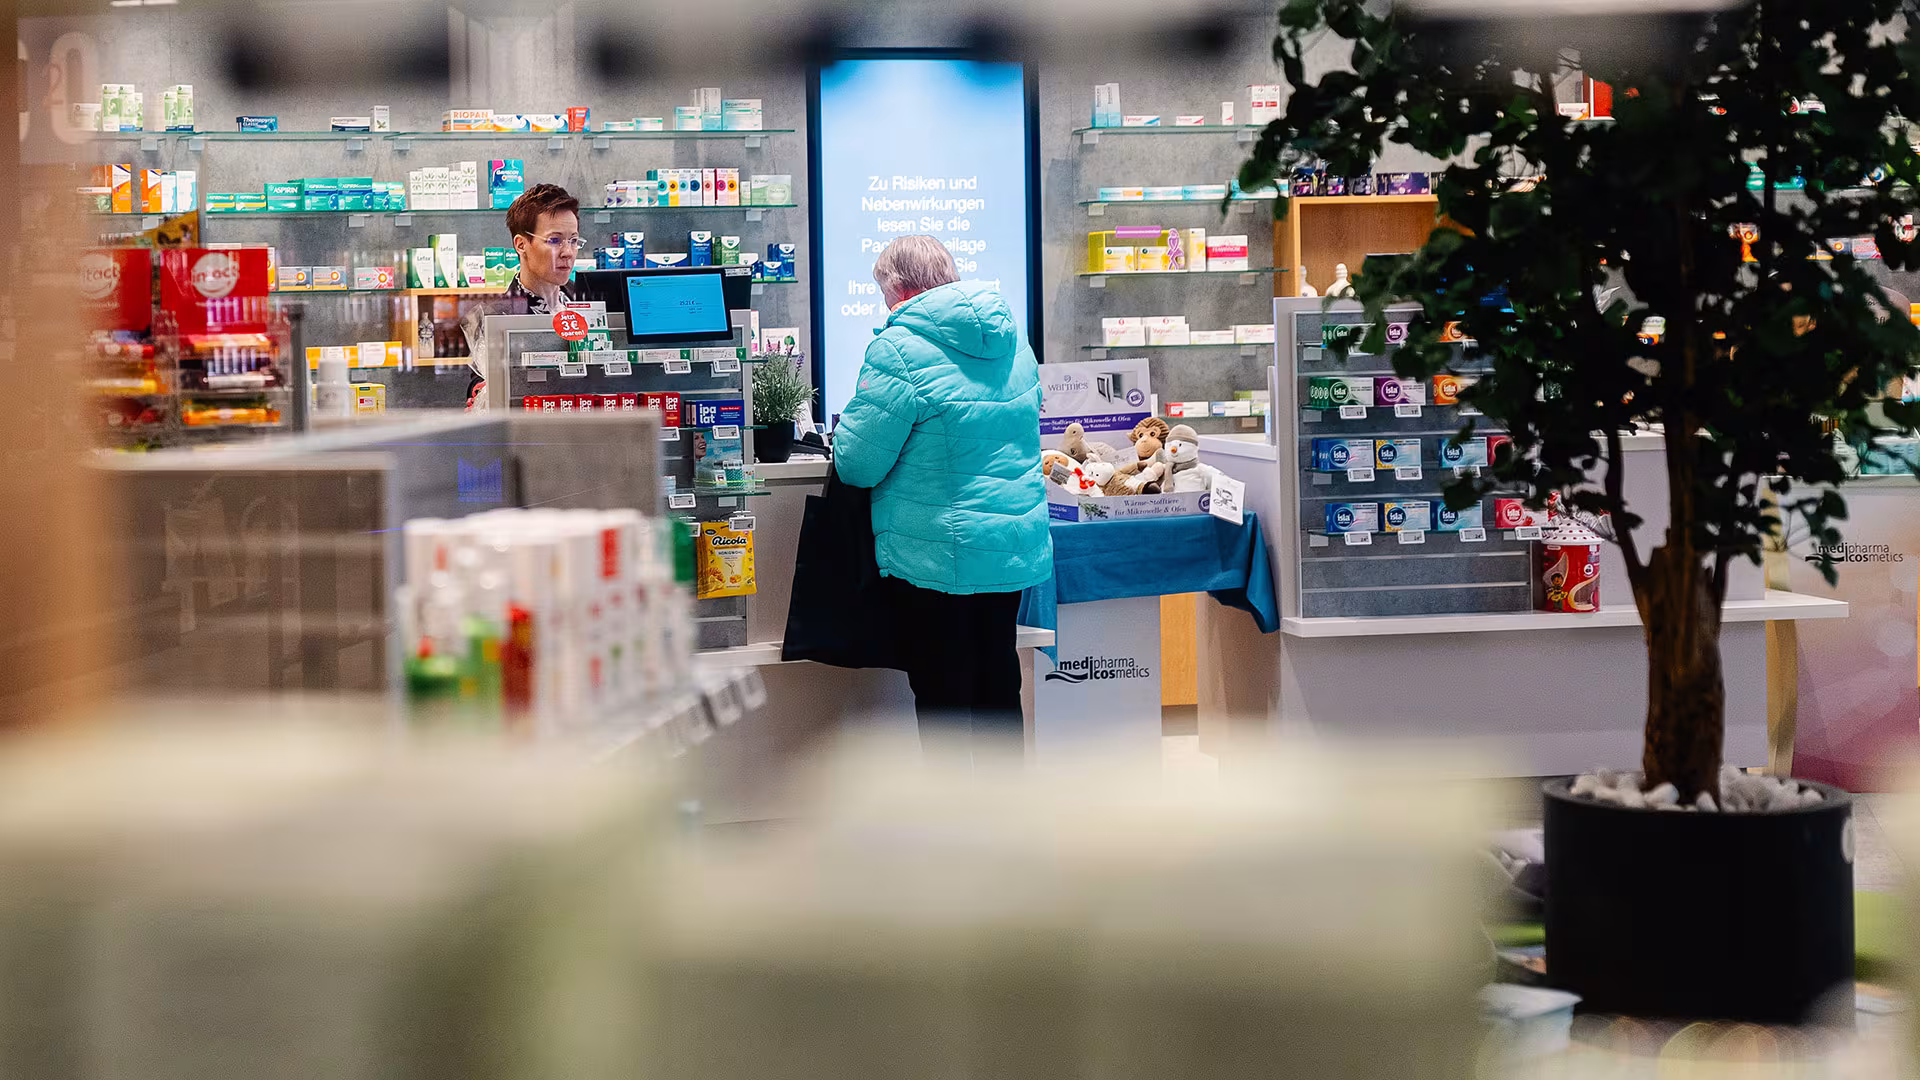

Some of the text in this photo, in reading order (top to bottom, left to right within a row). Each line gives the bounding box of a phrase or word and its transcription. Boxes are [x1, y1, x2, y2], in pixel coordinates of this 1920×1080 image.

[453, 111, 489, 119] RIOPAN
[868, 175, 977, 191] Zu Risiken und
[273, 186, 298, 194] ASPIRIN
[861, 197, 985, 213] Nebenwirkungen
[877, 217, 971, 232] lesen Sie die
[861, 238, 987, 255] Paceilage
[847, 280, 876, 295] Ihre
[841, 301, 876, 316] oder
[1047, 381, 1089, 392] warmies
[1385, 386, 1399, 394] isla
[543, 399, 556, 408] ipa
[560, 398, 573, 407] ipa
[580, 398, 592, 407] ipa
[604, 398, 616, 407] ipa
[622, 397, 635, 406] ipa
[648, 396, 660, 405] ipa
[666, 396, 678, 404] ipa
[666, 402, 677, 411] lat
[699, 404, 717, 416] ipa
[700, 413, 716, 424] lat
[1333, 450, 1347, 459] isla
[1381, 449, 1394, 457] isla
[1337, 513, 1351, 522] isla
[1389, 511, 1404, 520] isla
[1442, 510, 1456, 519] isla
[711, 535, 747, 546] Ricola
[1818, 542, 1890, 556] medipharma
[1848, 552, 1904, 563] cosmetics
[1059, 656, 1135, 672] medipharma
[1093, 665, 1150, 680] cosmetics
